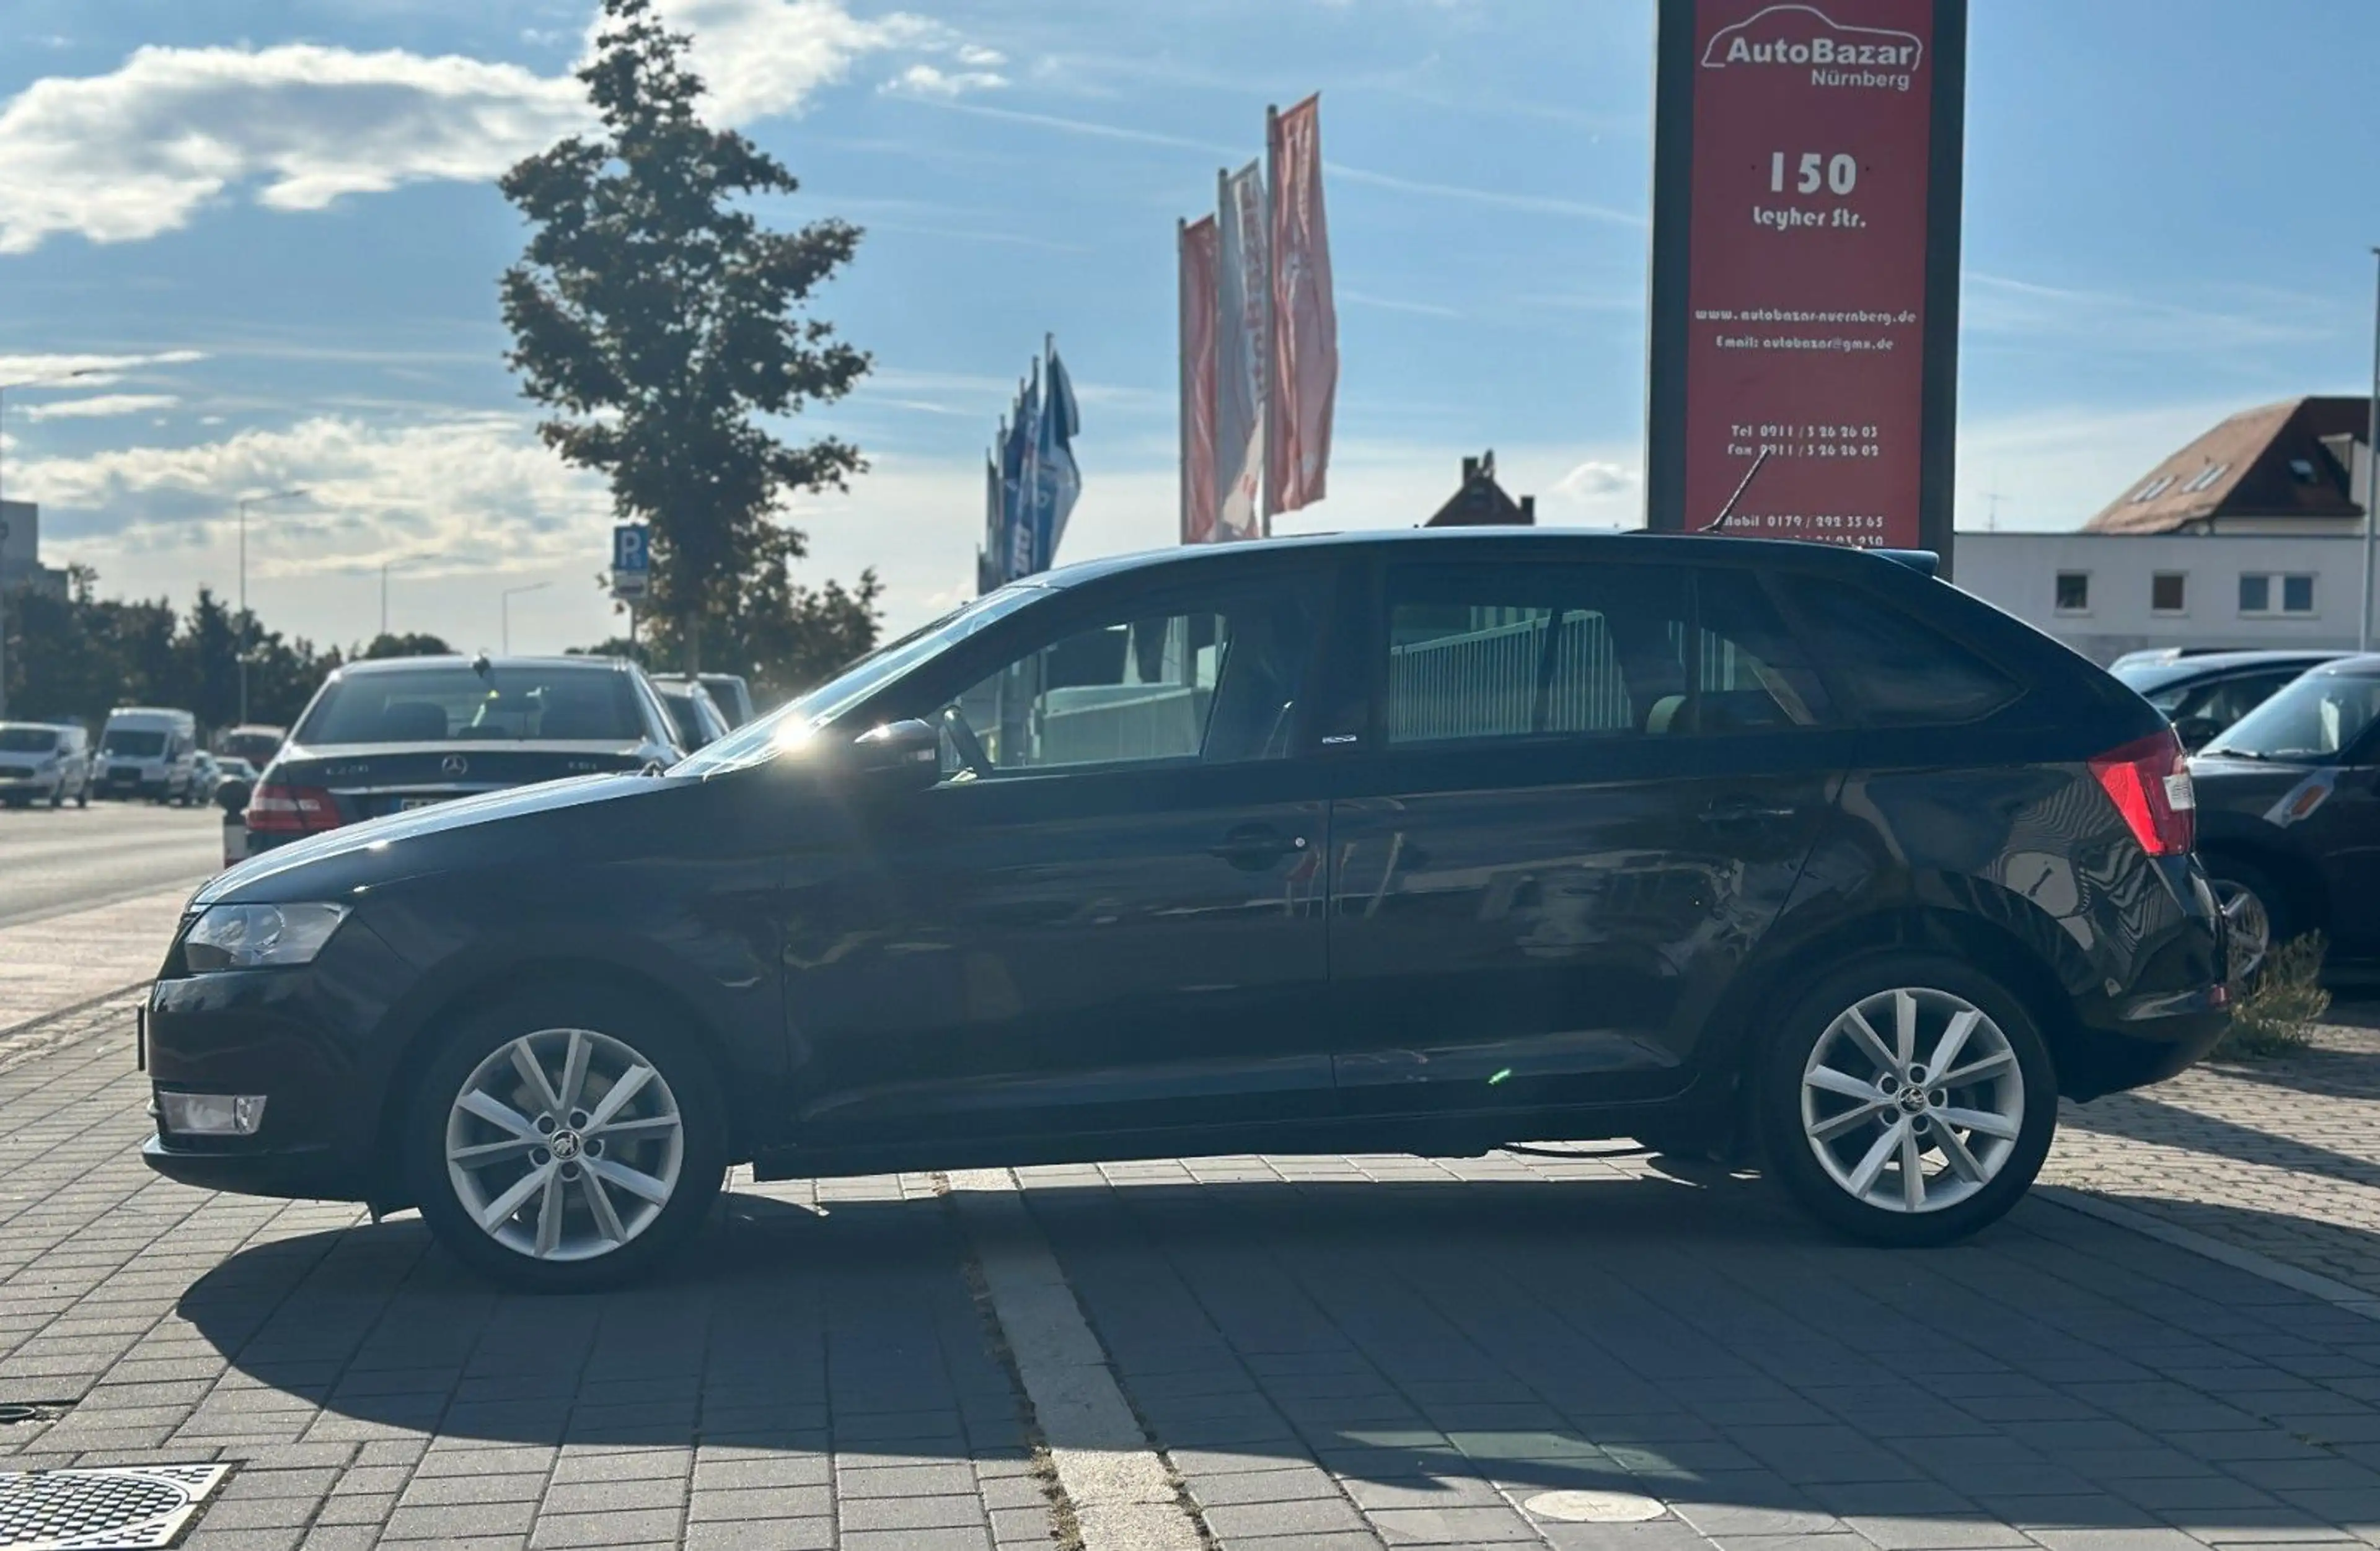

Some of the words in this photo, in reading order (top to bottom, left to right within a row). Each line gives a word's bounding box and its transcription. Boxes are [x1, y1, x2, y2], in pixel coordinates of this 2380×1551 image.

[1727, 37, 1913, 64] AutoBazar
[1812, 69, 1910, 91] Nürnberg
[1771, 152, 1856, 195] 150
[1831, 208, 1866, 228] Str.
[1731, 424, 1752, 437] Tel
[1760, 424, 1793, 437] 0911
[1727, 444, 1752, 455] Fax
[1767, 515, 1802, 527] 0179
